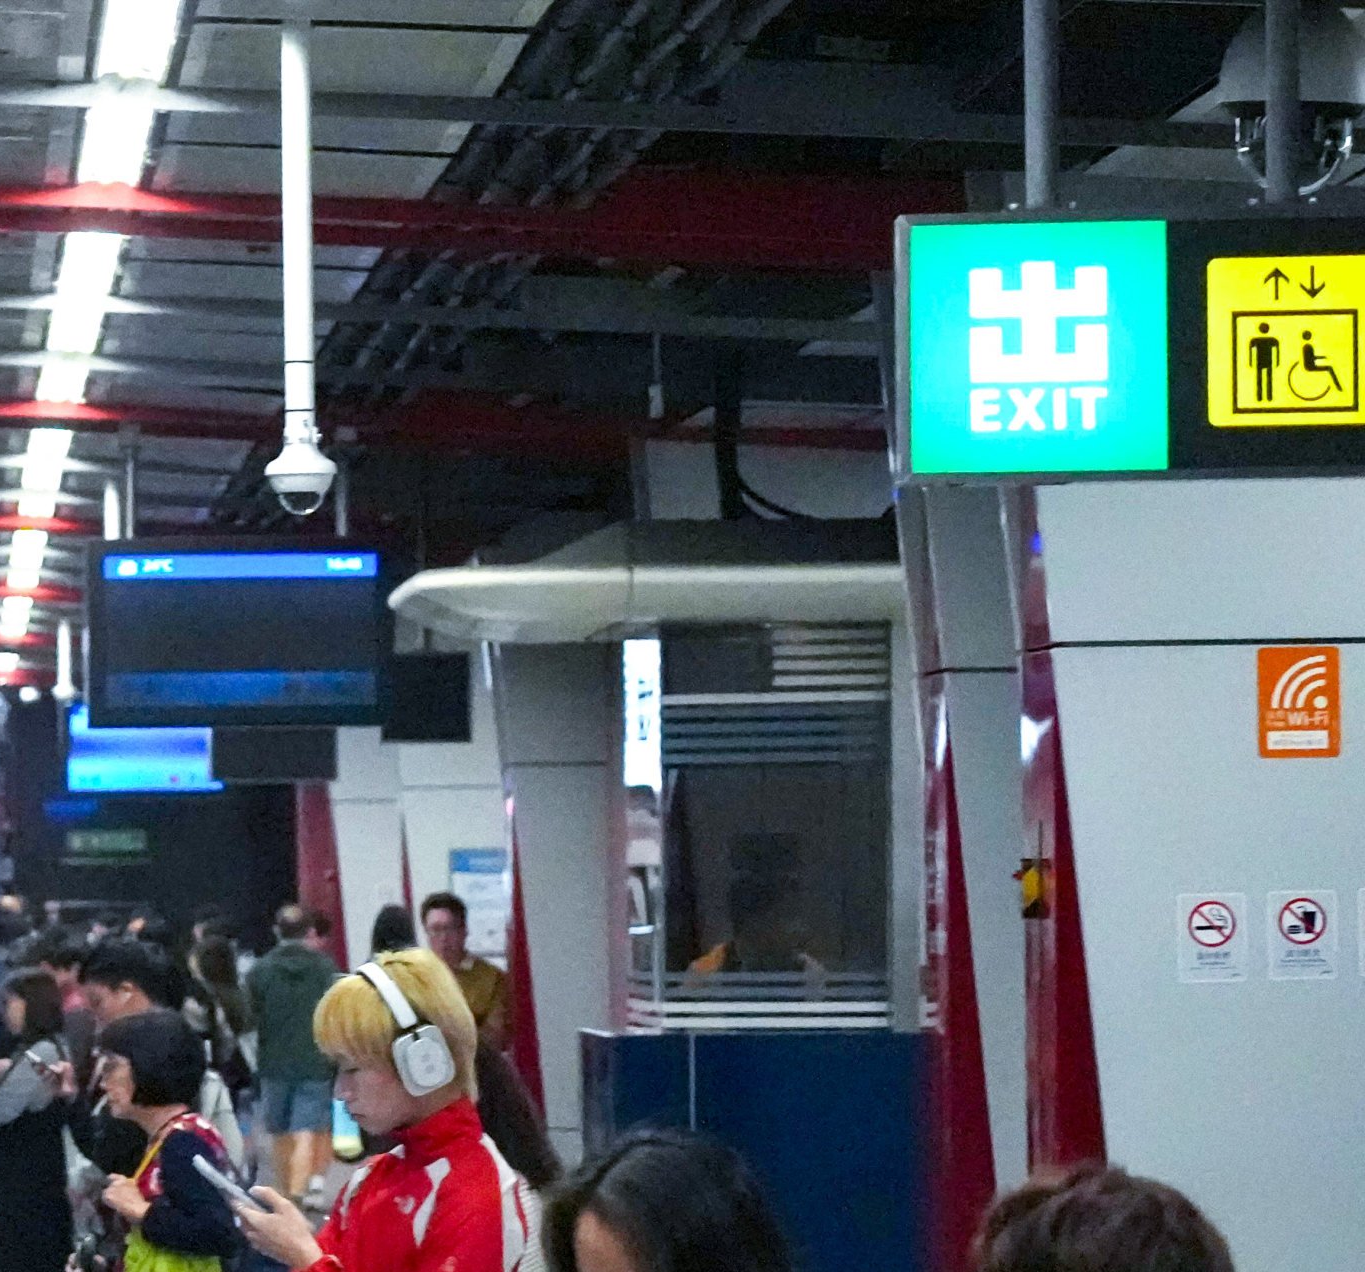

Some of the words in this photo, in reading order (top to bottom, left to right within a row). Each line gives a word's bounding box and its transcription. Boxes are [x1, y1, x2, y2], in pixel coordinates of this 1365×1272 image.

[969, 260, 1108, 383] 出
[970, 387, 1108, 432] EXIT
[1287, 710, 1330, 727] Wi-Fi
